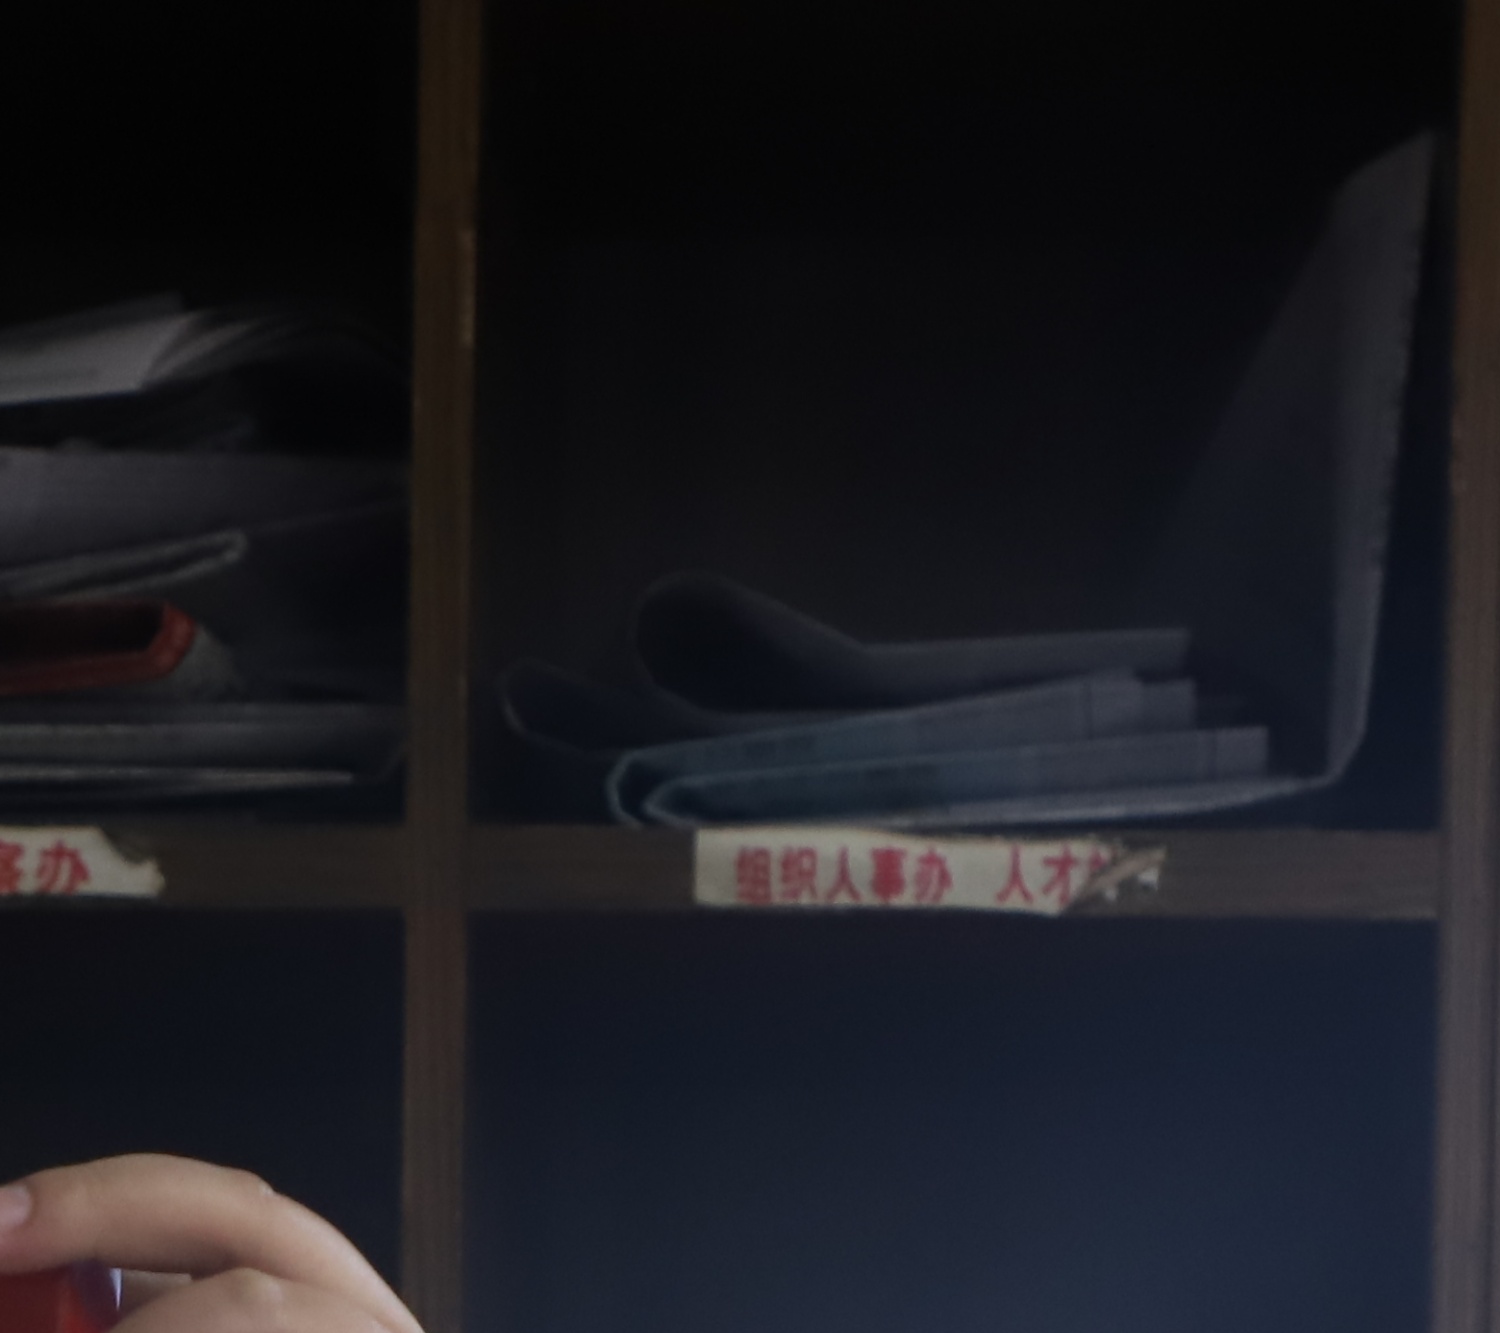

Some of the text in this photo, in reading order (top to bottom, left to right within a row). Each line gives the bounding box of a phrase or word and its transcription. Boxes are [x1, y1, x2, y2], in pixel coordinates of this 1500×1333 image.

[735, 847, 952, 904] 组织人事办
